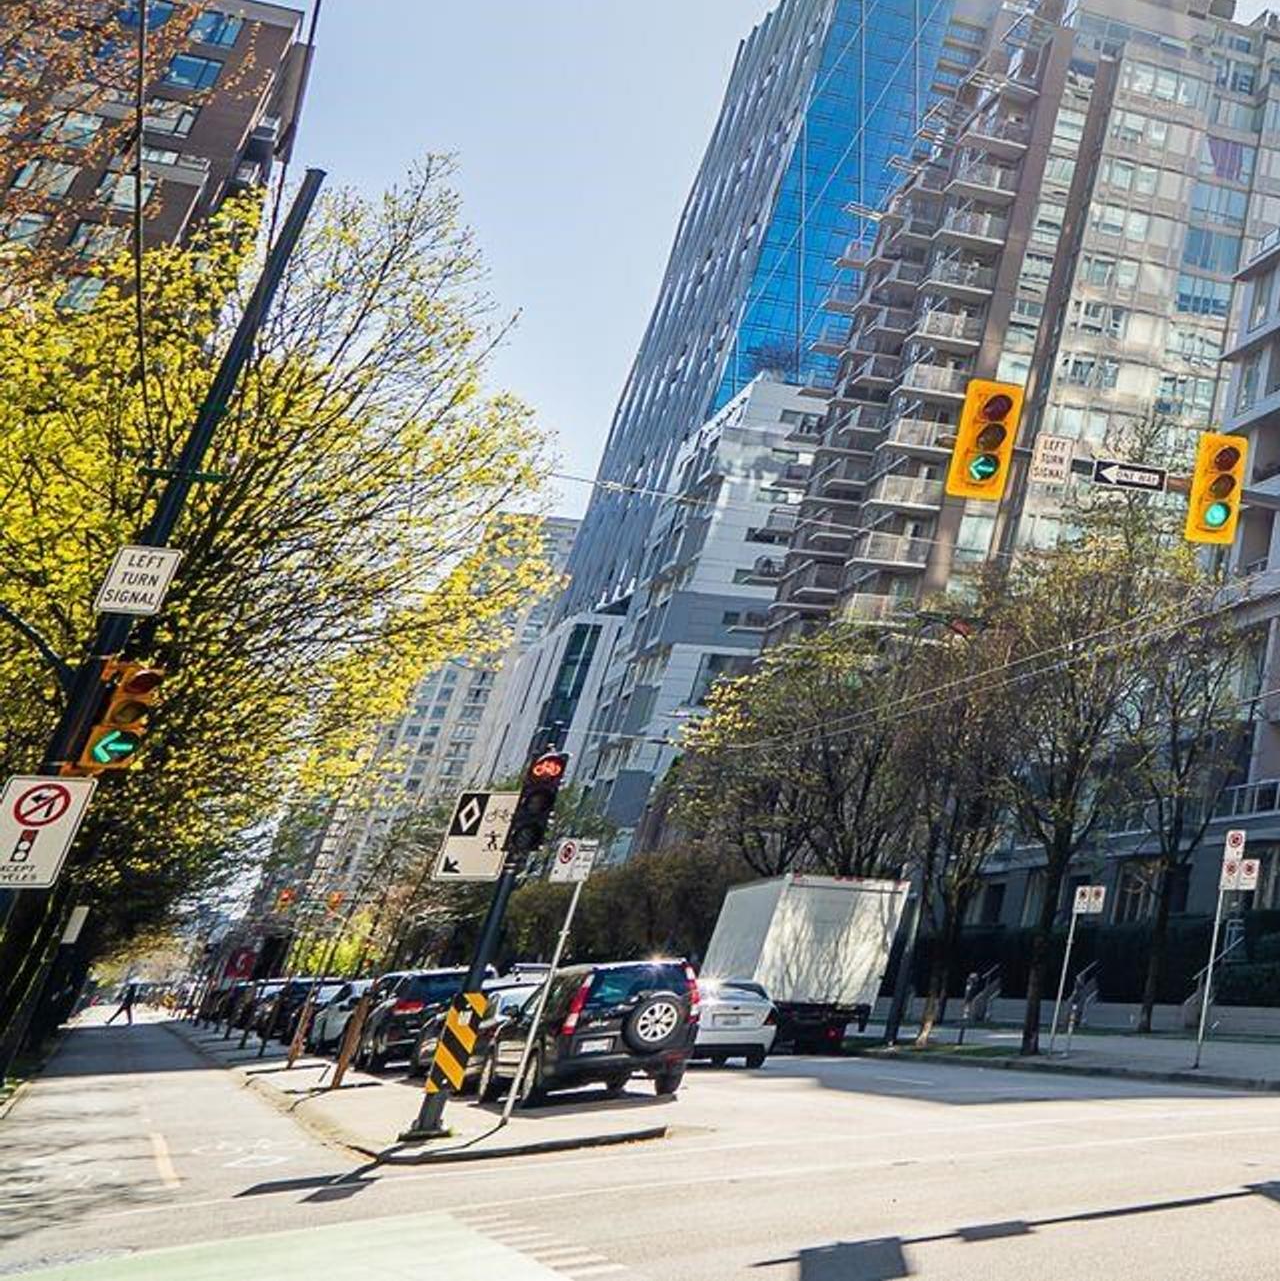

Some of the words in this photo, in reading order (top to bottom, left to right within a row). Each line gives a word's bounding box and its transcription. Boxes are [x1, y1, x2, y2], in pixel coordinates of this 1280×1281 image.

[1043, 439, 1066, 451] LEFT
[1042, 452, 1064, 464] TURN
[1033, 466, 1064, 480] SIGNAL
[1115, 470, 1135, 480] ONE
[1137, 473, 1158, 484] WAY
[128, 553, 165, 569] LEFT
[120, 571, 160, 587] TURN
[104, 589, 156, 606] SIGNAL
